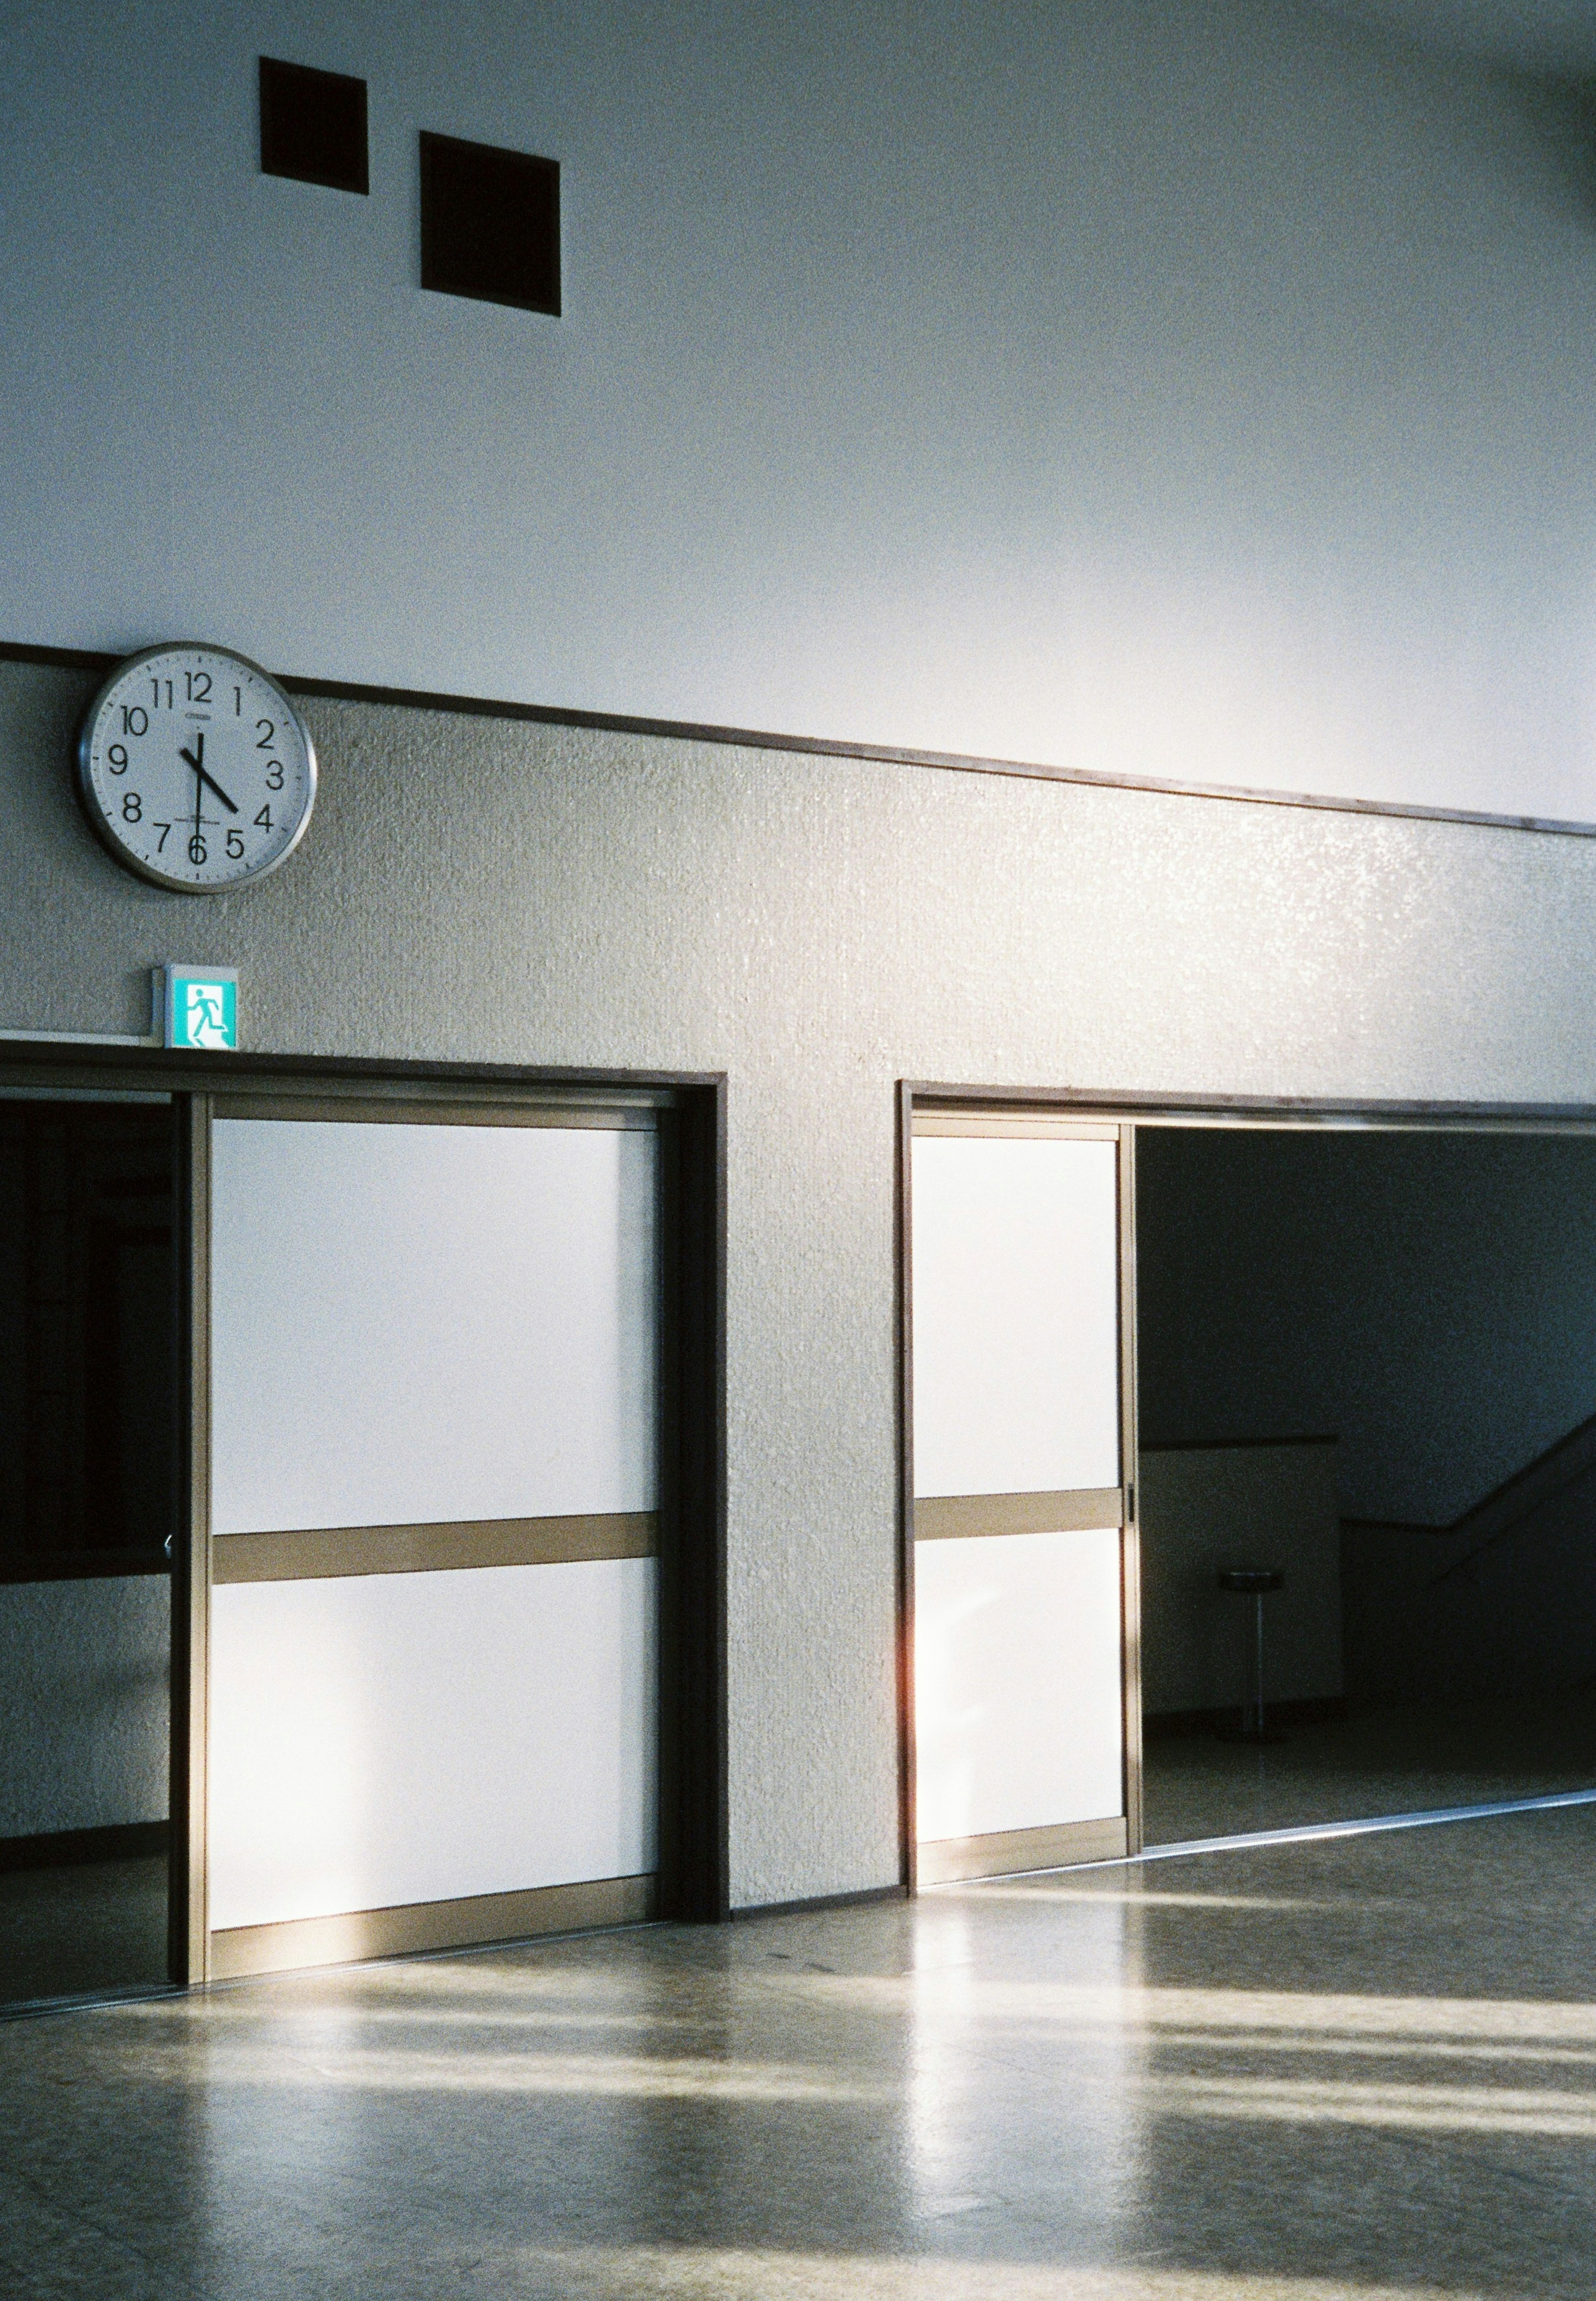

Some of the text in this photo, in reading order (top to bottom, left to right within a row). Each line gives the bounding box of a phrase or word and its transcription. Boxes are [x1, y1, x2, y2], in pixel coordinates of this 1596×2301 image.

[151, 678, 172, 709] 11
[185, 672, 212, 703] 12
[233, 686, 241, 716] 1
[121, 705, 148, 736] 10
[256, 719, 274, 749] 2
[108, 744, 128, 775] 9
[266, 760, 284, 791] 3
[123, 792, 142, 823] 8
[254, 804, 274, 833] 4
[153, 823, 171, 853] 7
[188, 835, 207, 865] 6
[226, 829, 244, 860] 5
